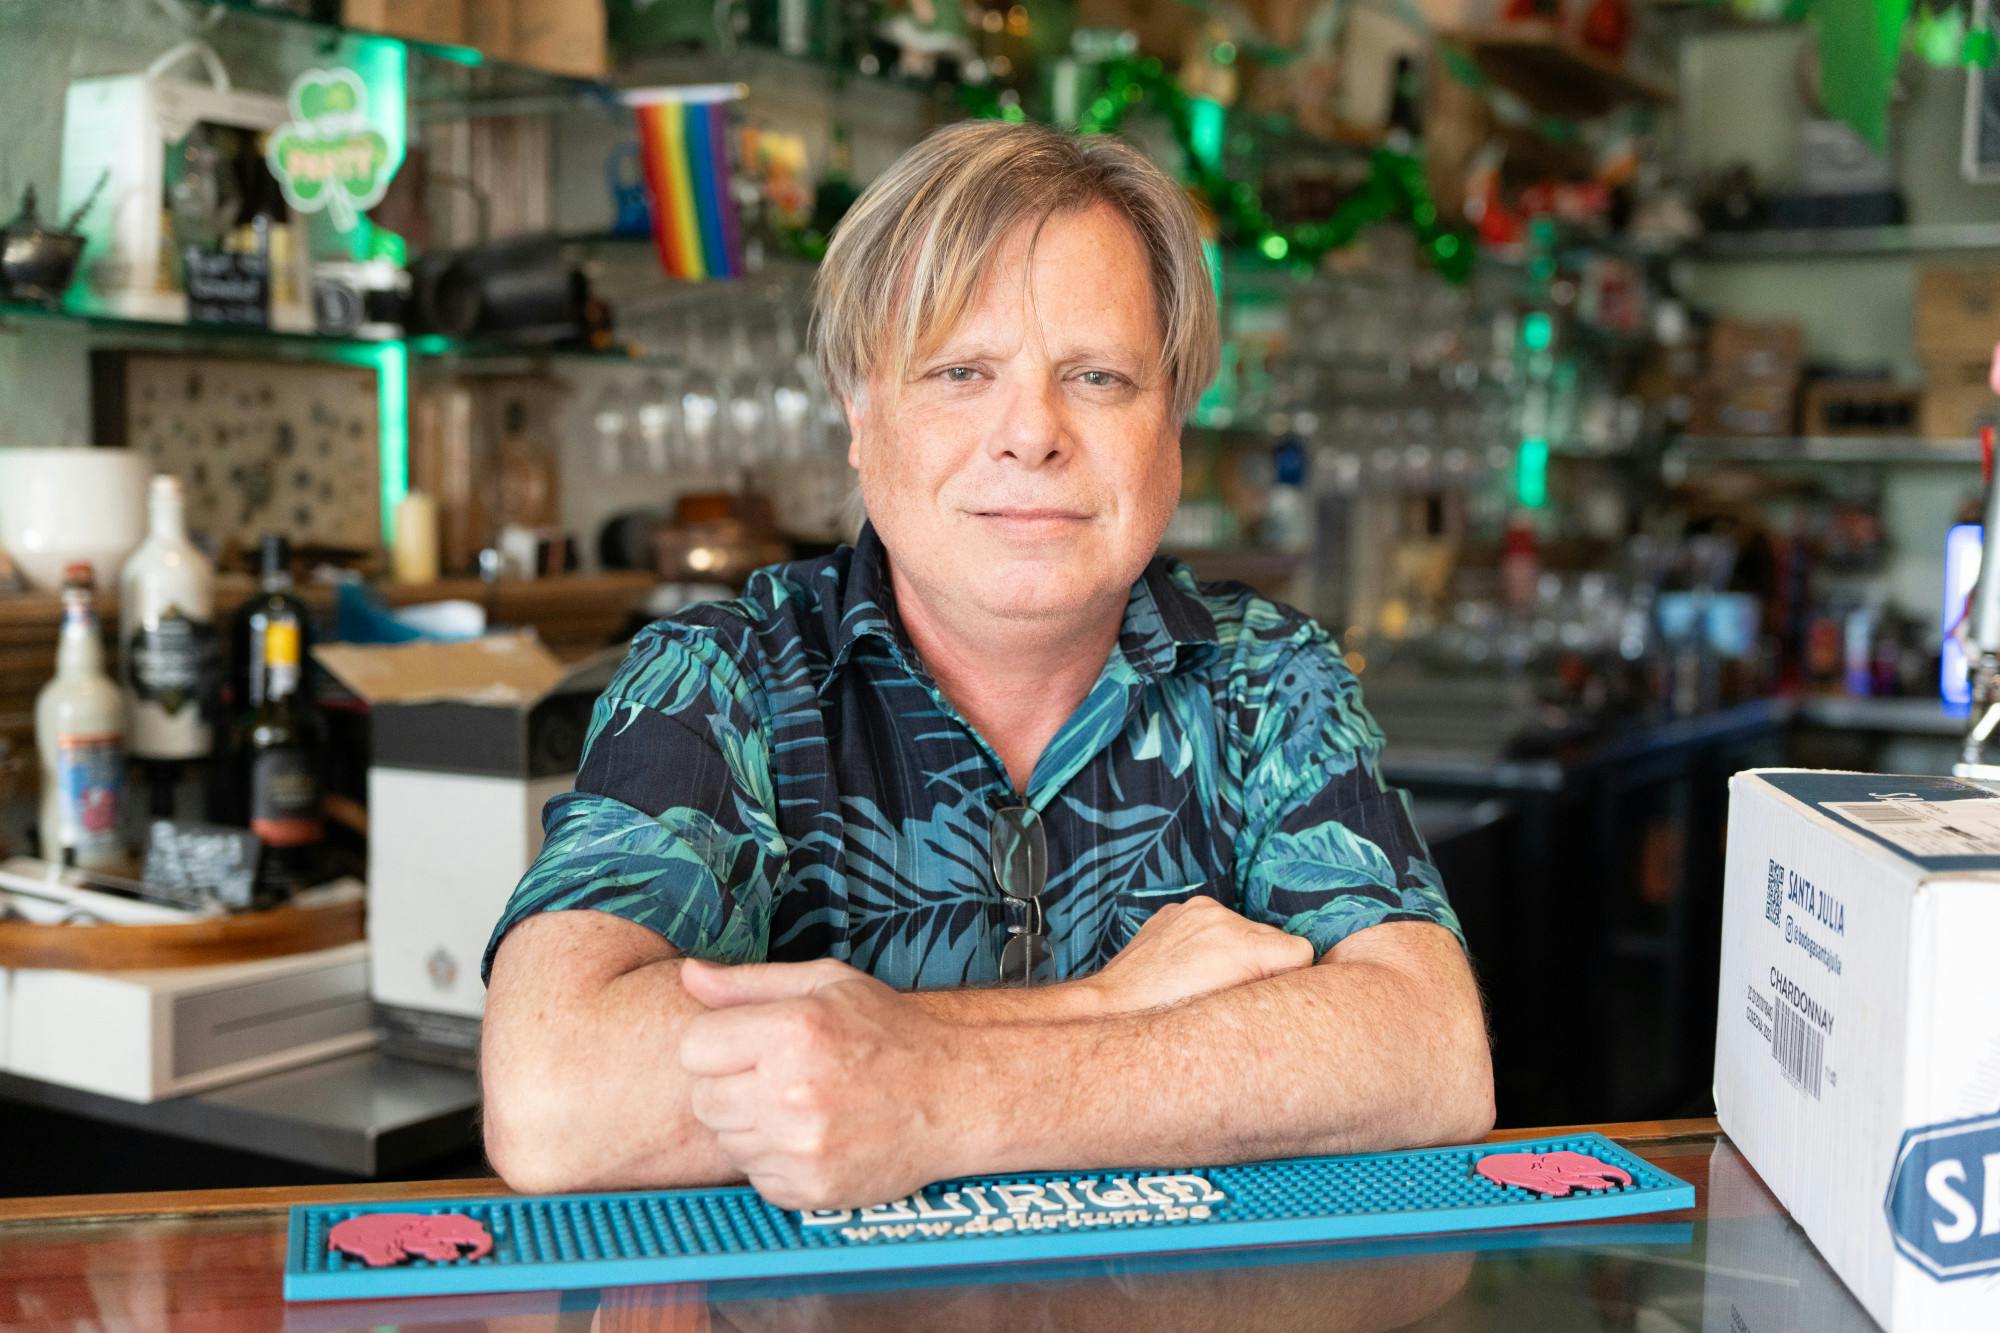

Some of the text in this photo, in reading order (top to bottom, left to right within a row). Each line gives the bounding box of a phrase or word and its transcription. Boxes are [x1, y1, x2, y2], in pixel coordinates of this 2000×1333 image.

[1788, 869, 1844, 937] SANTA JULIA
[1769, 965, 1834, 1036] CHARDONNAY
[841, 1204, 1211, 1241] www.delirium.be
